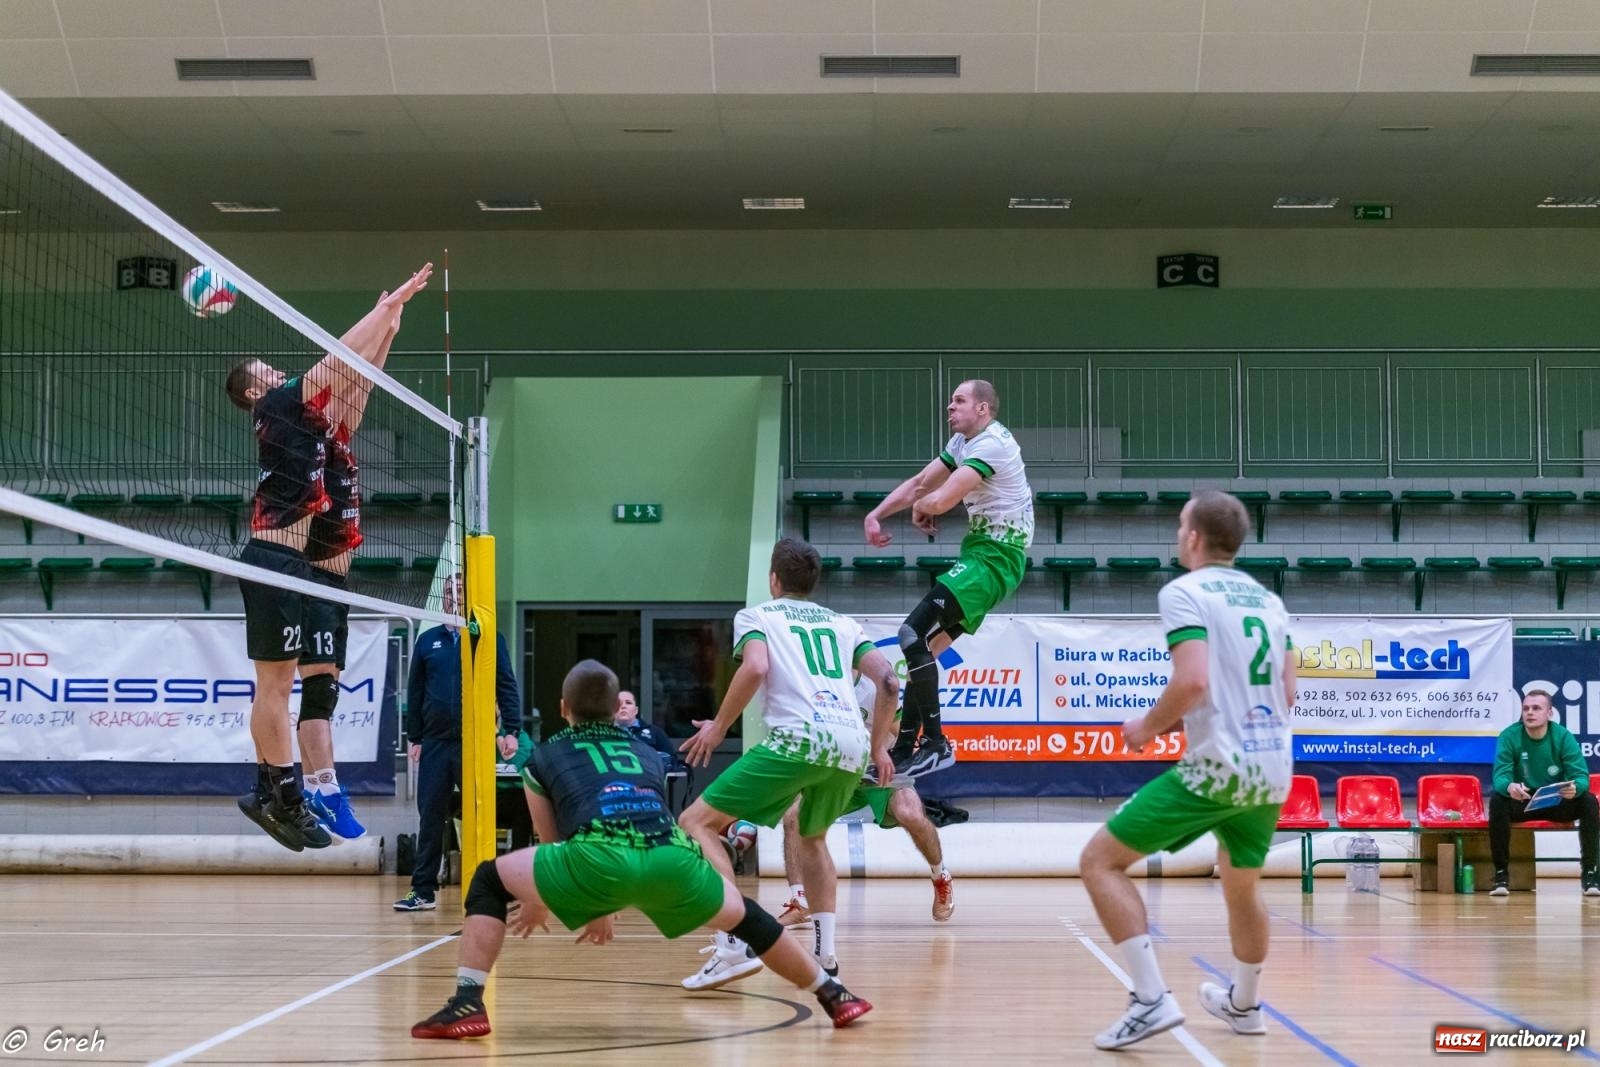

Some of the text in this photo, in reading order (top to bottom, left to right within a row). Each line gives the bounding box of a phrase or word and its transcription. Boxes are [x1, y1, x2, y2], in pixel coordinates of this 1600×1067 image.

[149, 267, 169, 286] B
[1163, 264, 1184, 283] C
[1197, 264, 1215, 283] C
[283, 625, 302, 652] 22
[313, 631, 334, 655] 13
[790, 625, 843, 679] 10
[1055, 648, 1097, 661] Biura
[1101, 651, 1114, 661] w
[1243, 616, 1272, 686] 2
[948, 669, 1020, 684] MULTI
[1071, 673, 1168, 689] ul. Opawska
[1071, 694, 1091, 708] ul.
[1304, 690, 1318, 701] 92
[1321, 690, 1340, 702] 88,
[1345, 691, 1367, 701] 502
[1370, 691, 1392, 701] 632
[1396, 691, 1421, 703] 695,
[1427, 692, 1450, 702] 606
[1453, 691, 1473, 702] 363
[1476, 691, 1498, 702] 647
[1294, 705, 1491, 719] Racibórz, ul. J. von Eichendorffa 2
[1073, 731, 1115, 755] 570
[1302, 740, 1435, 755] www.instal-tech.pl
[574, 742, 644, 775] 15
